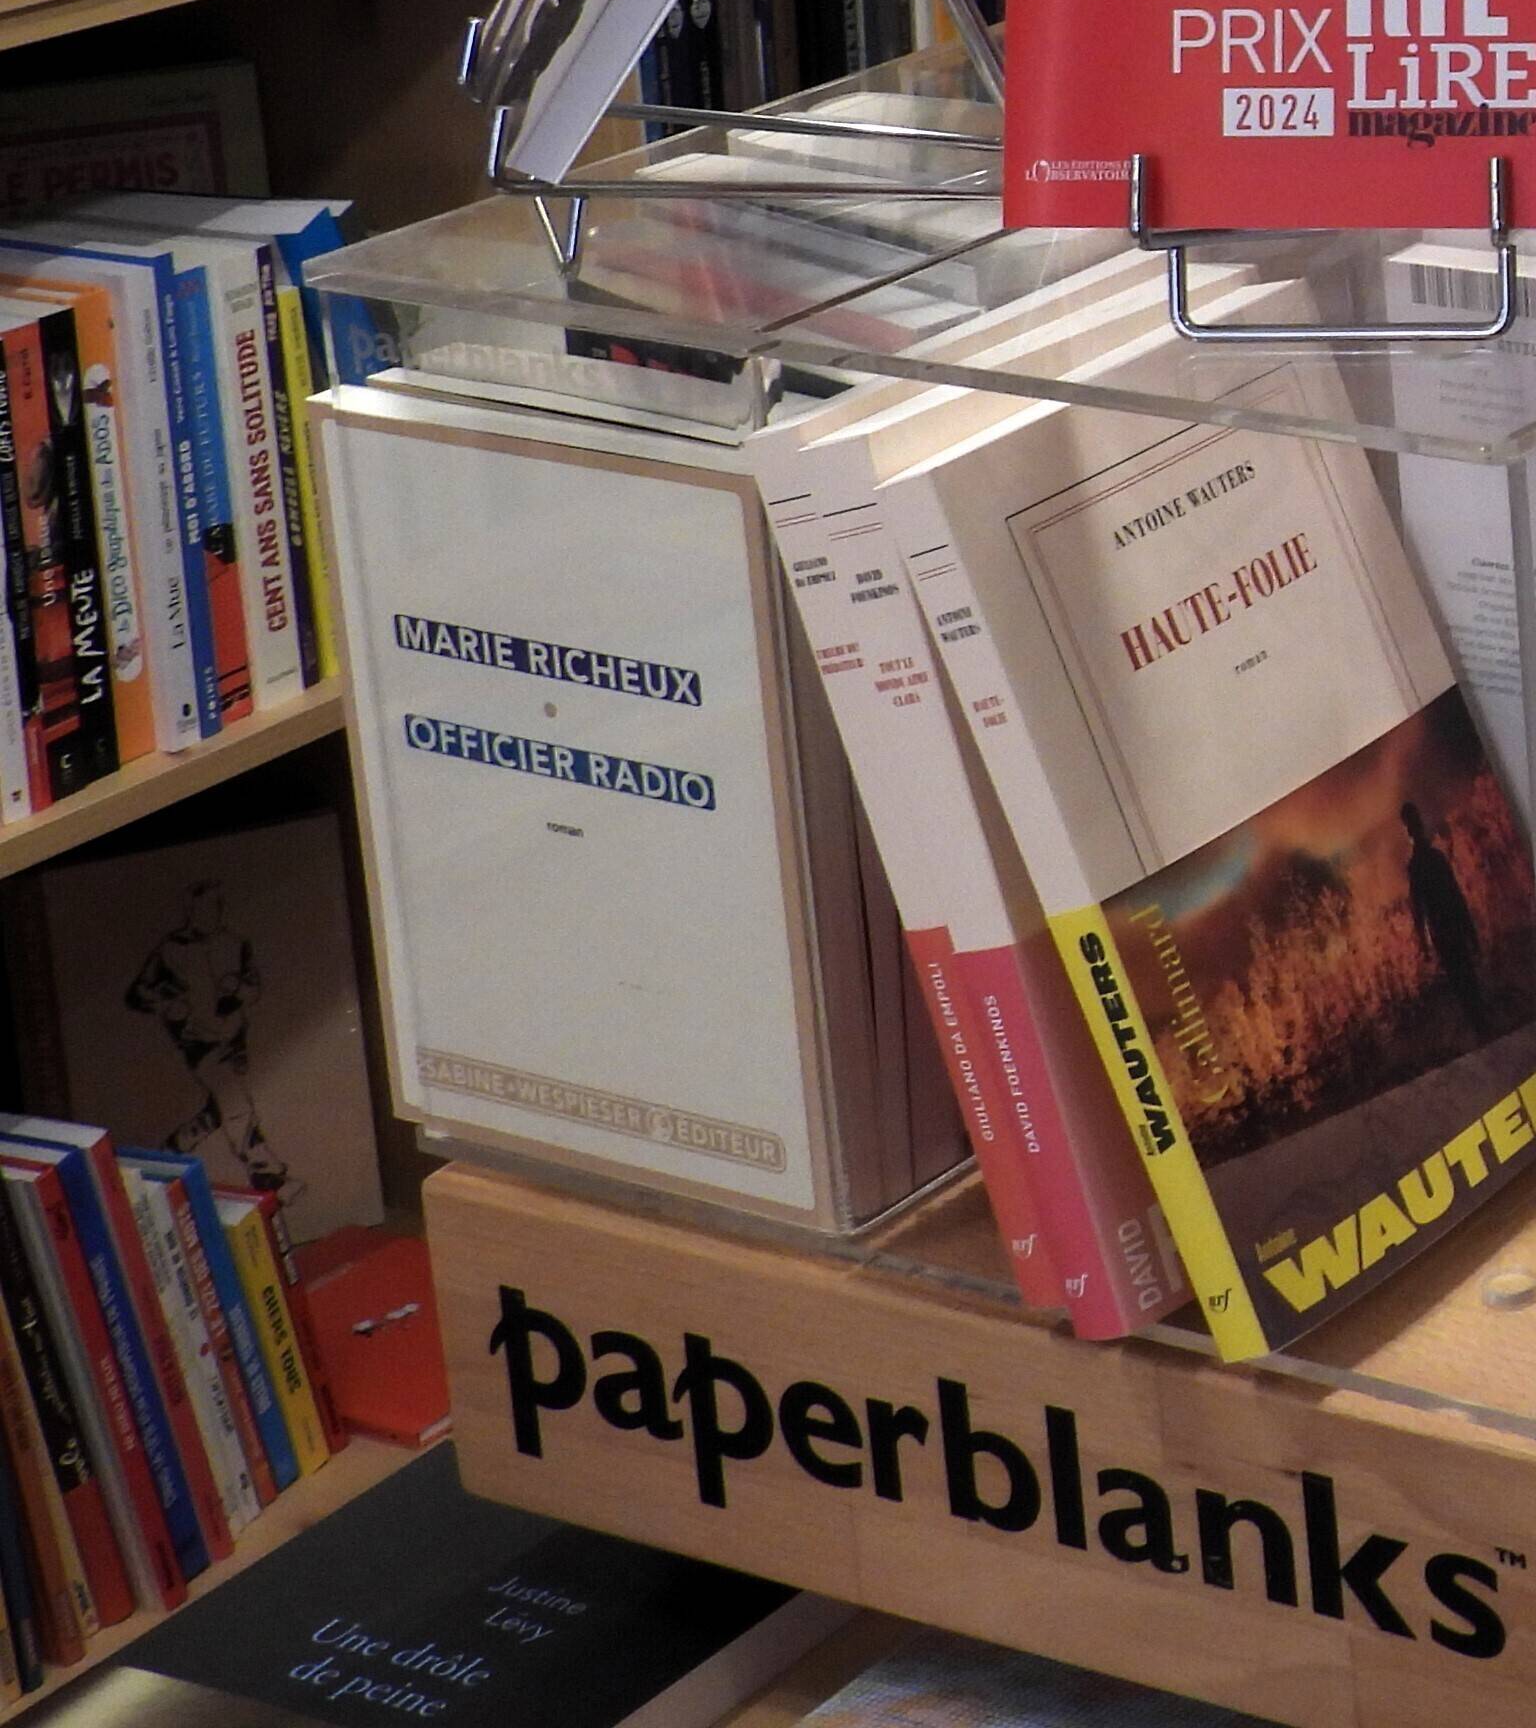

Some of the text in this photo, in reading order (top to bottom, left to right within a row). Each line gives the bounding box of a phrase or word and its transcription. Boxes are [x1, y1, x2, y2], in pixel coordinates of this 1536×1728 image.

[1173, 8, 1334, 75] PRIX
[1235, 93, 1322, 131] 2024
[234, 328, 266, 445] SOLITUDE
[94, 413, 115, 467] ADOS
[248, 449, 275, 514] SANS
[1112, 457, 1258, 553] ANTOINE WAUTERS
[257, 517, 281, 568] ANS
[71, 568, 106, 705] LA MEUTE
[264, 574, 289, 633] CENT
[1119, 532, 1320, 672] HAUTE-FOLIE
[398, 615, 699, 707] MARIE RICHEUX
[1234, 648, 1270, 675] roman
[408, 714, 711, 809] OFFICIER RADIO
[547, 822, 584, 838] roman
[928, 961, 995, 1142] GIULIANO DA EMPOLI
[983, 993, 1041, 1155] DAVID FOENKINOS
[1078, 931, 1177, 1157] WAUTERS
[1117, 1216, 1163, 1311] DAVID
[483, 1606, 555, 1645] Lévy
[486, 1575, 588, 1616] Justine
[310, 1617, 491, 1688] Une drôle
[288, 1656, 447, 1719] de peine
